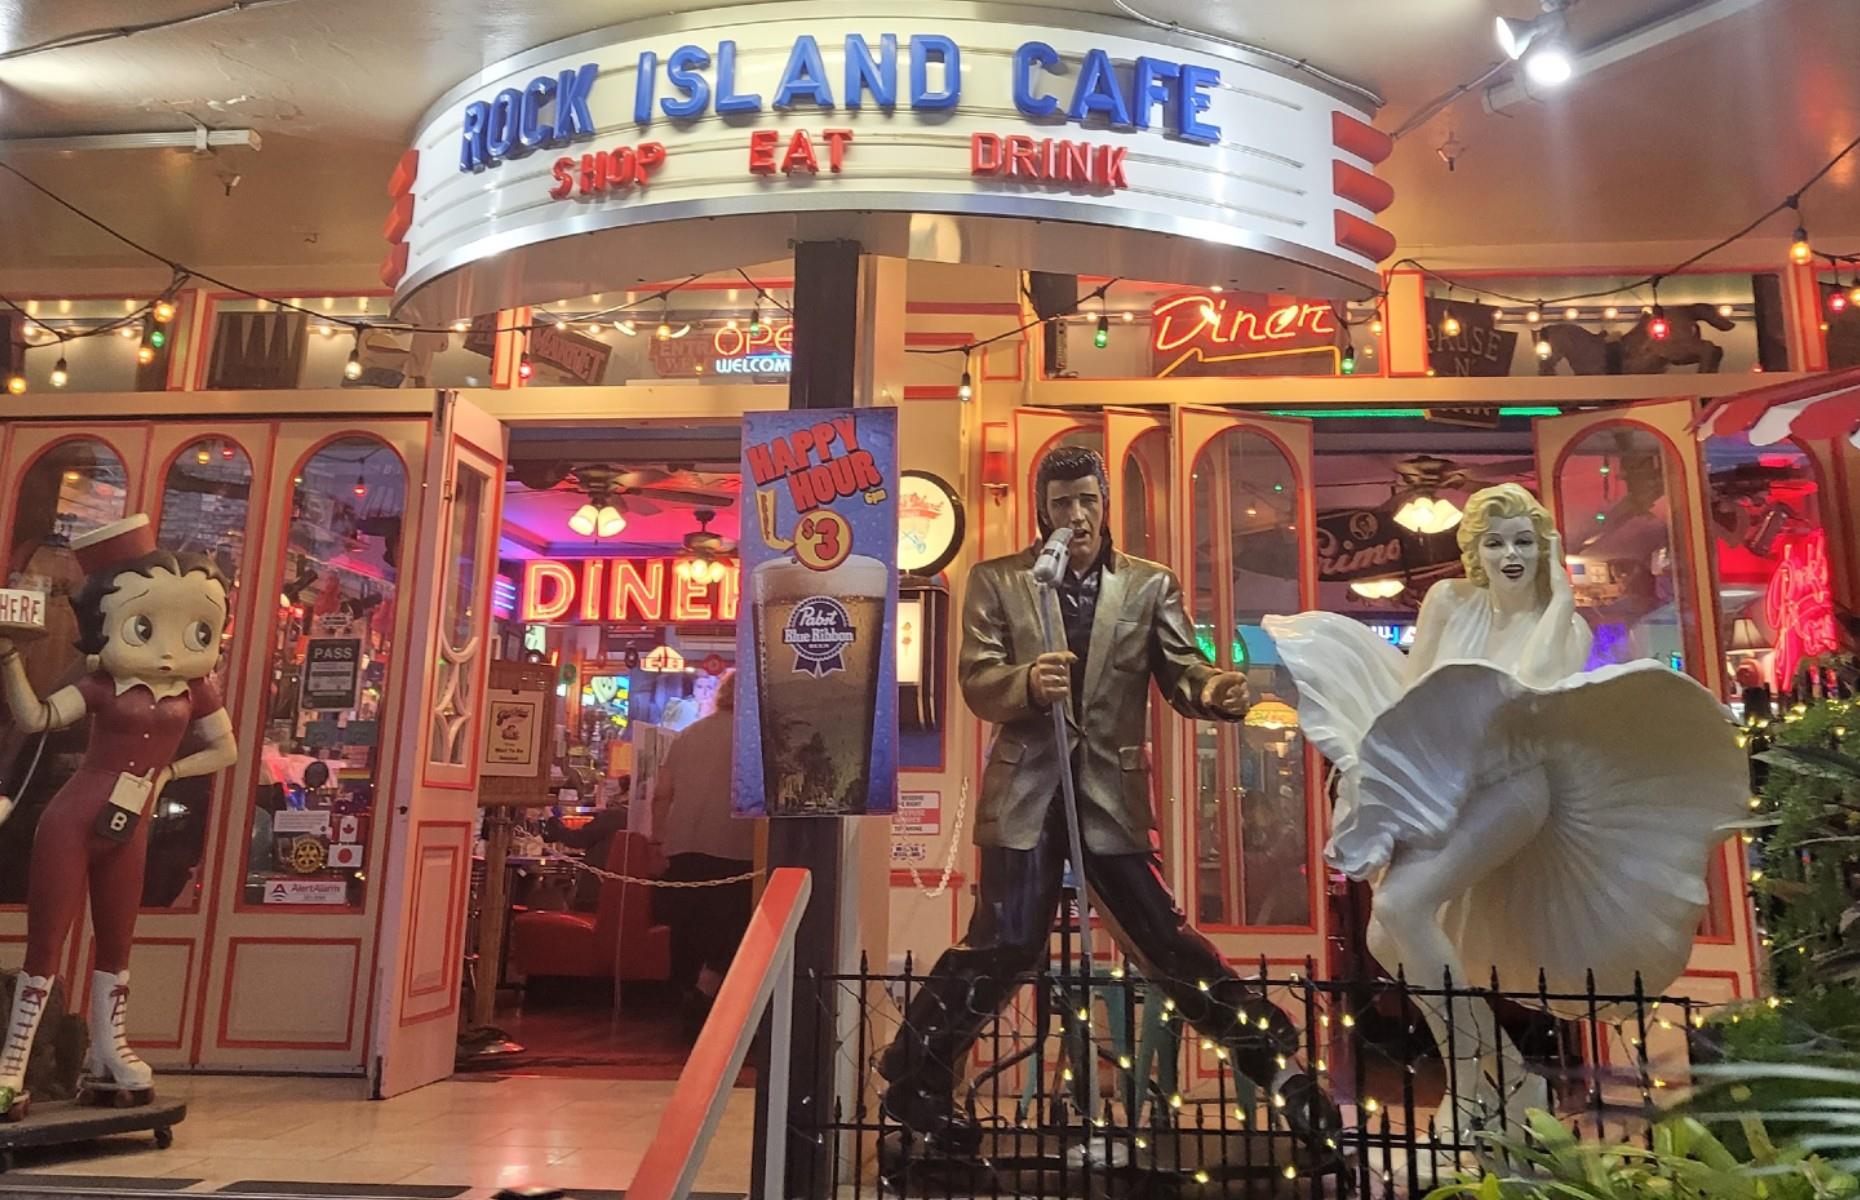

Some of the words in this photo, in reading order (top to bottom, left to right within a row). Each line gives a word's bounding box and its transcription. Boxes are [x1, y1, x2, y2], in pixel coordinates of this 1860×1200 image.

[459, 63, 599, 173] ROCK
[634, 33, 961, 126] ISLAND
[1012, 41, 1222, 144] CAFE
[548, 142, 667, 200] SHOP
[749, 129, 853, 176] EAT
[971, 132, 1128, 189] DRINK
[714, 324, 792, 356] OPE
[1154, 296, 1335, 350] Diner
[715, 358, 791, 373] WELCOM
[747, 414, 859, 486] HAPPY
[788, 449, 883, 513] HOUR
[802, 518, 840, 561] $3
[784, 628, 810, 643] Blue
[811, 627, 855, 643] Ribbon
[799, 606, 838, 627] Pabst
[313, 647, 353, 659] PASS
[110, 811, 128, 831] B
